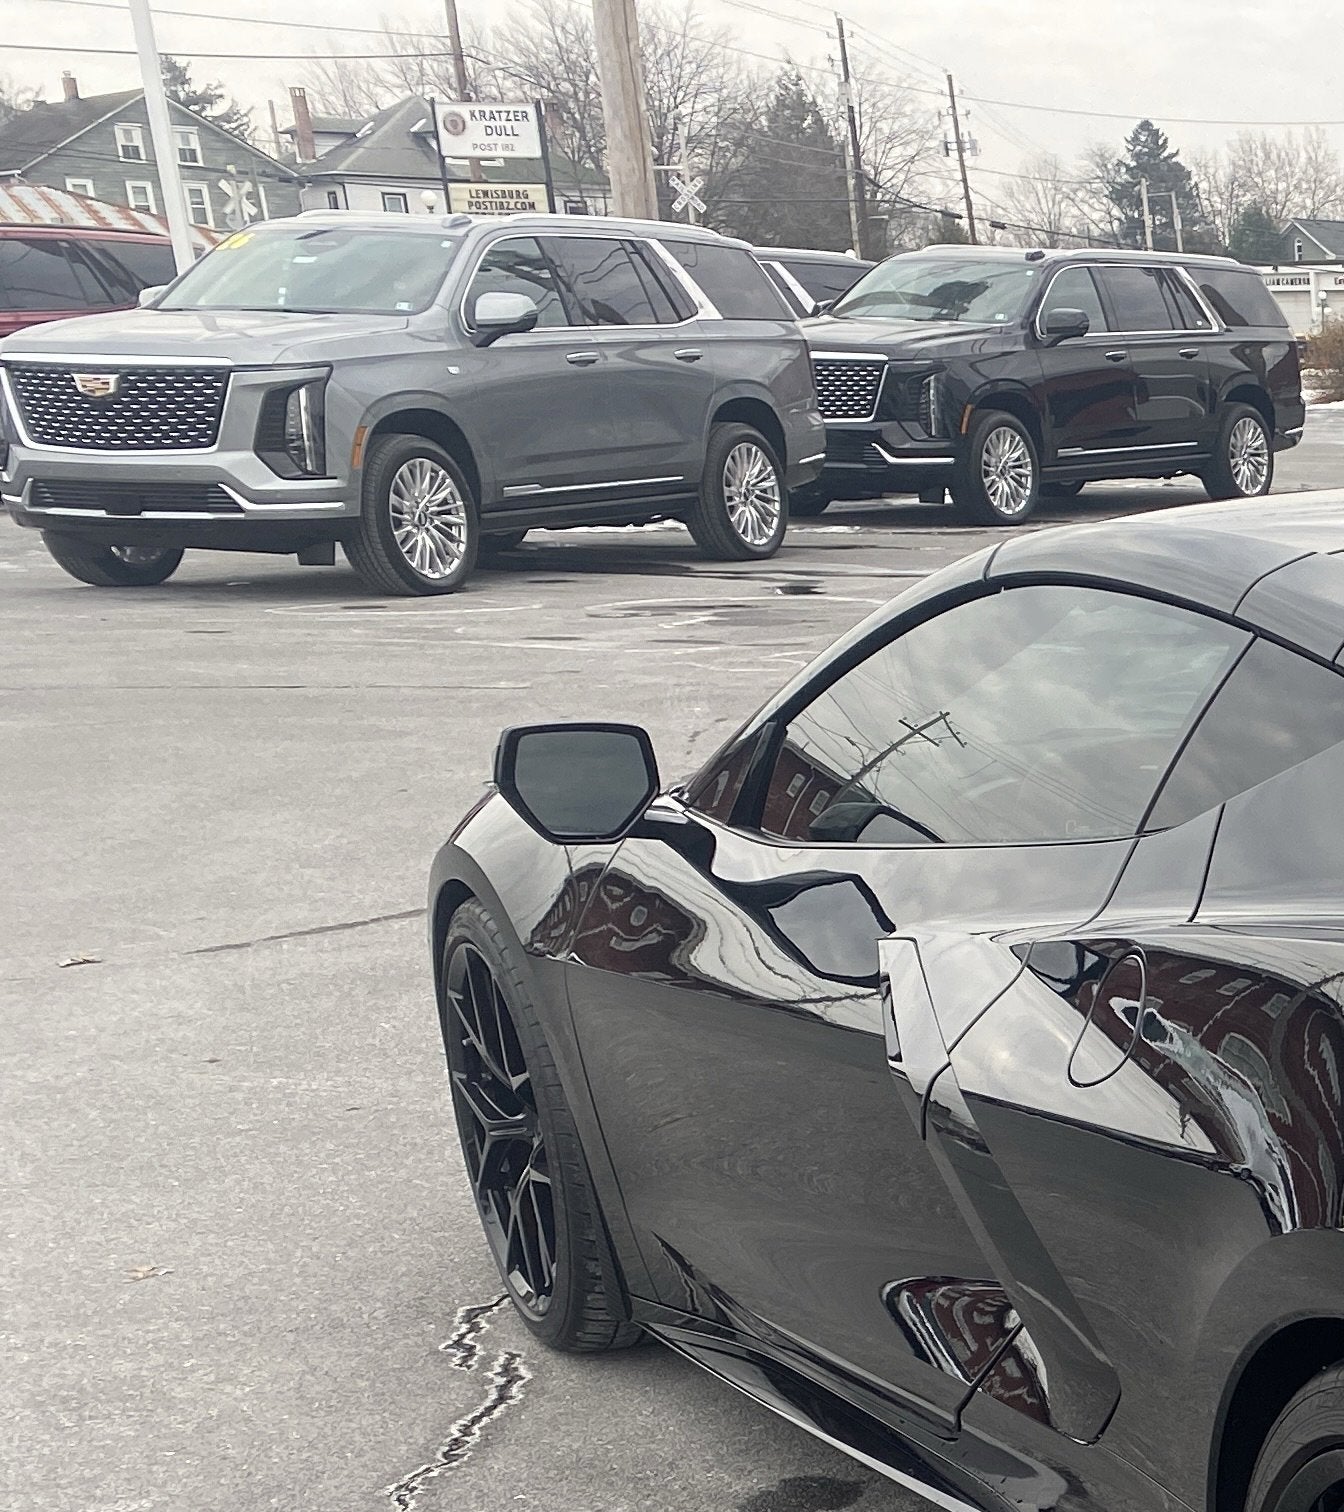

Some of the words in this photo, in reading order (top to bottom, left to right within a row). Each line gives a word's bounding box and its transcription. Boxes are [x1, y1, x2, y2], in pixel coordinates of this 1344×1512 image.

[469, 109, 530, 122] KRATZER
[484, 125, 520, 137] DULL
[472, 143, 498, 151] POST
[501, 143, 516, 152] 182
[468, 188, 529, 200] LEWISBURG
[1265, 277, 1281, 286] LIAM
